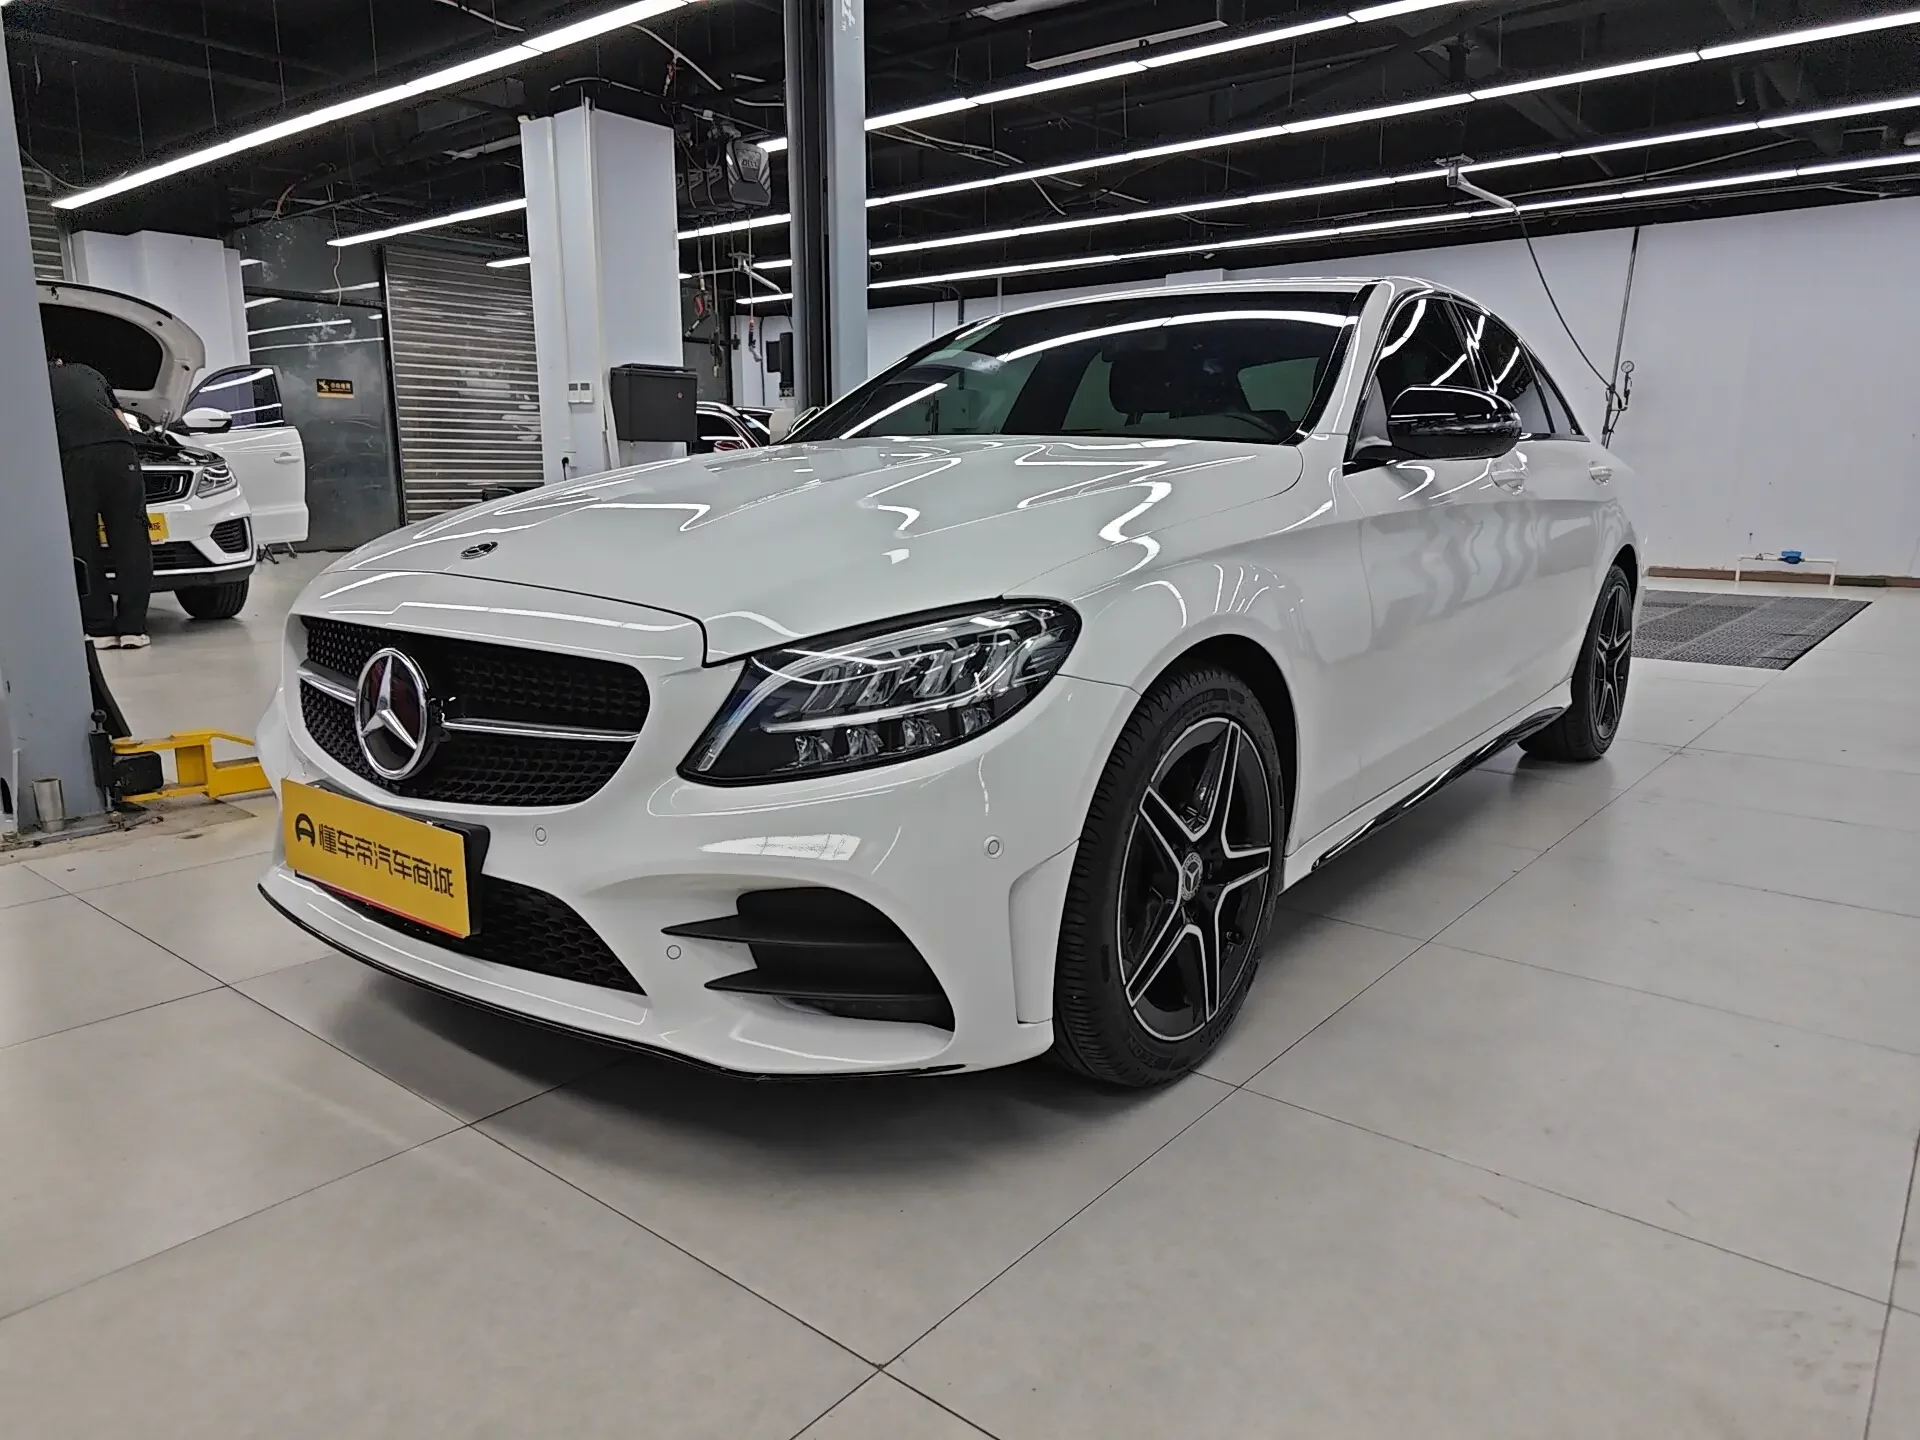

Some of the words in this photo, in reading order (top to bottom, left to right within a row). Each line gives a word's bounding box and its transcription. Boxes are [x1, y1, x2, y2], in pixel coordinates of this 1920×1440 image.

[319, 823, 454, 898] 懂车帝汽车商城
